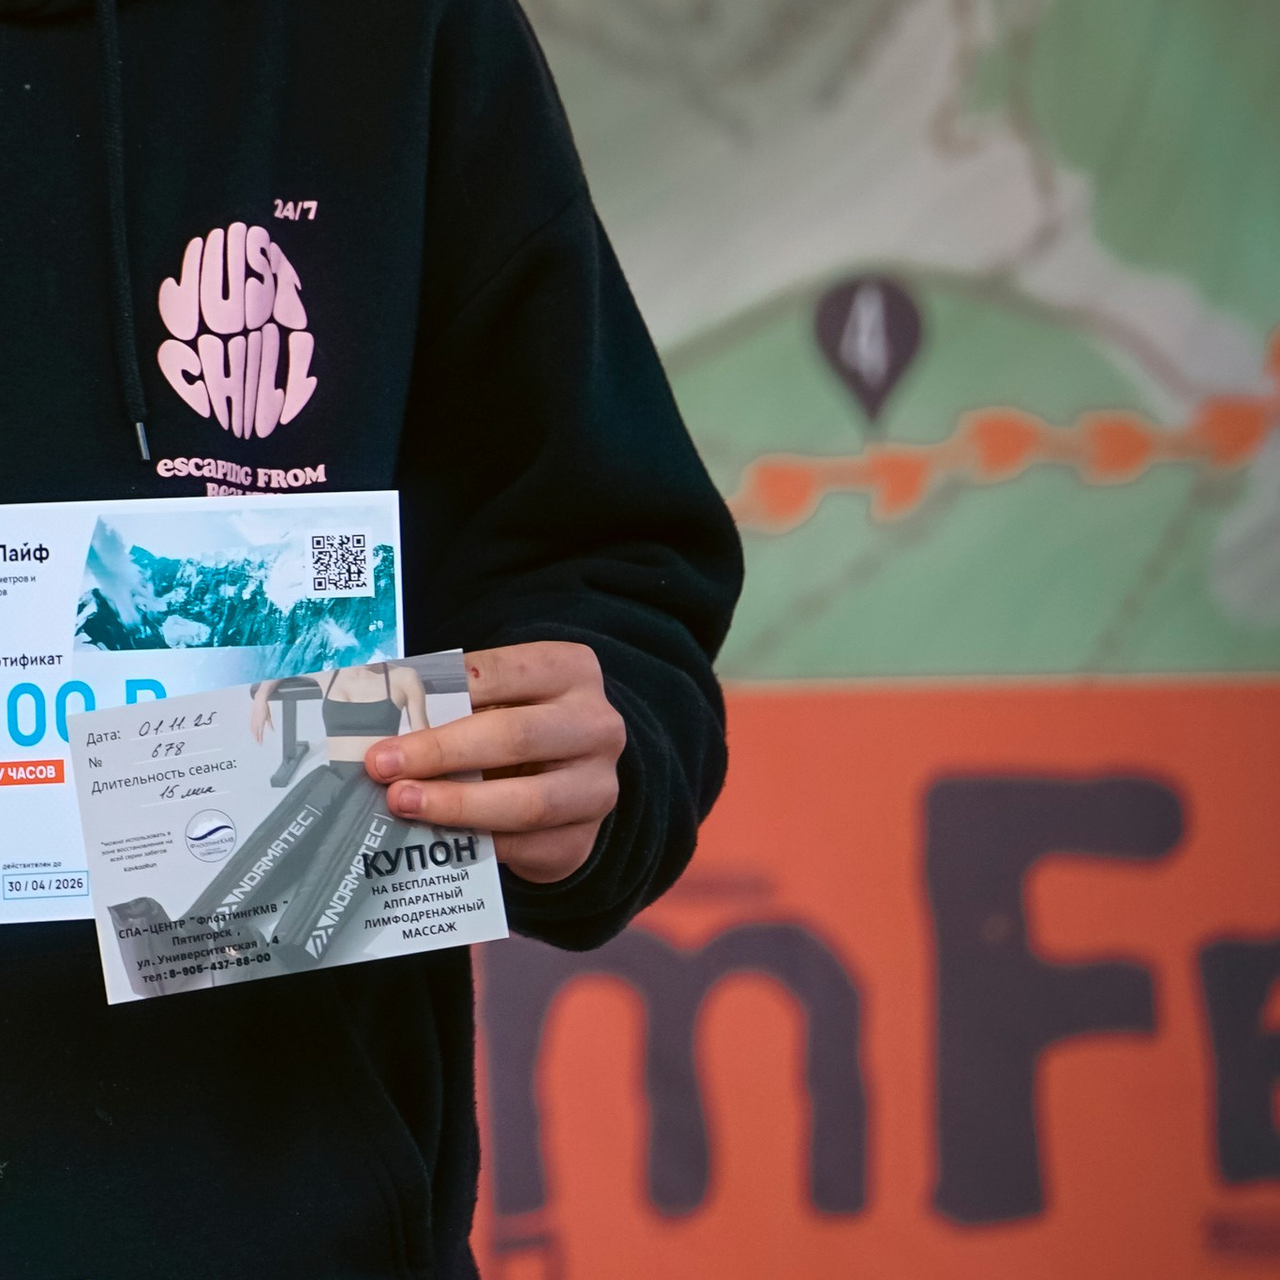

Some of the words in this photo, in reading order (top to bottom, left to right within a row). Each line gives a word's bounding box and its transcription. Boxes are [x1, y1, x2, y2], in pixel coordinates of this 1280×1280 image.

[274, 199, 318, 221] 24/7
[158, 221, 309, 341] JUST
[157, 322, 318, 440] CHILL
[256, 464, 327, 489] FROM
[30, 575, 36, 583] и
[86, 729, 121, 747] Дата:
[8, 766, 56, 779] ЧАСОВ
[91, 769, 186, 795] Длительность
[189, 758, 238, 776] сеанса:
[231, 810, 314, 901] NORMATEC
[362, 836, 478, 879] КУПОН
[371, 885, 388, 895] НА
[392, 869, 470, 893] БЕСПЛАТНЫЙ
[383, 886, 463, 910] АППАРАТНЫЙ
[364, 899, 485, 929] ЛИМФОДРЕНАЖНЫЙ
[119, 919, 186, 939] СПА-ЦЕНТР
[172, 928, 232, 946] Пятигорск
[402, 921, 457, 939] МАССАЖ
